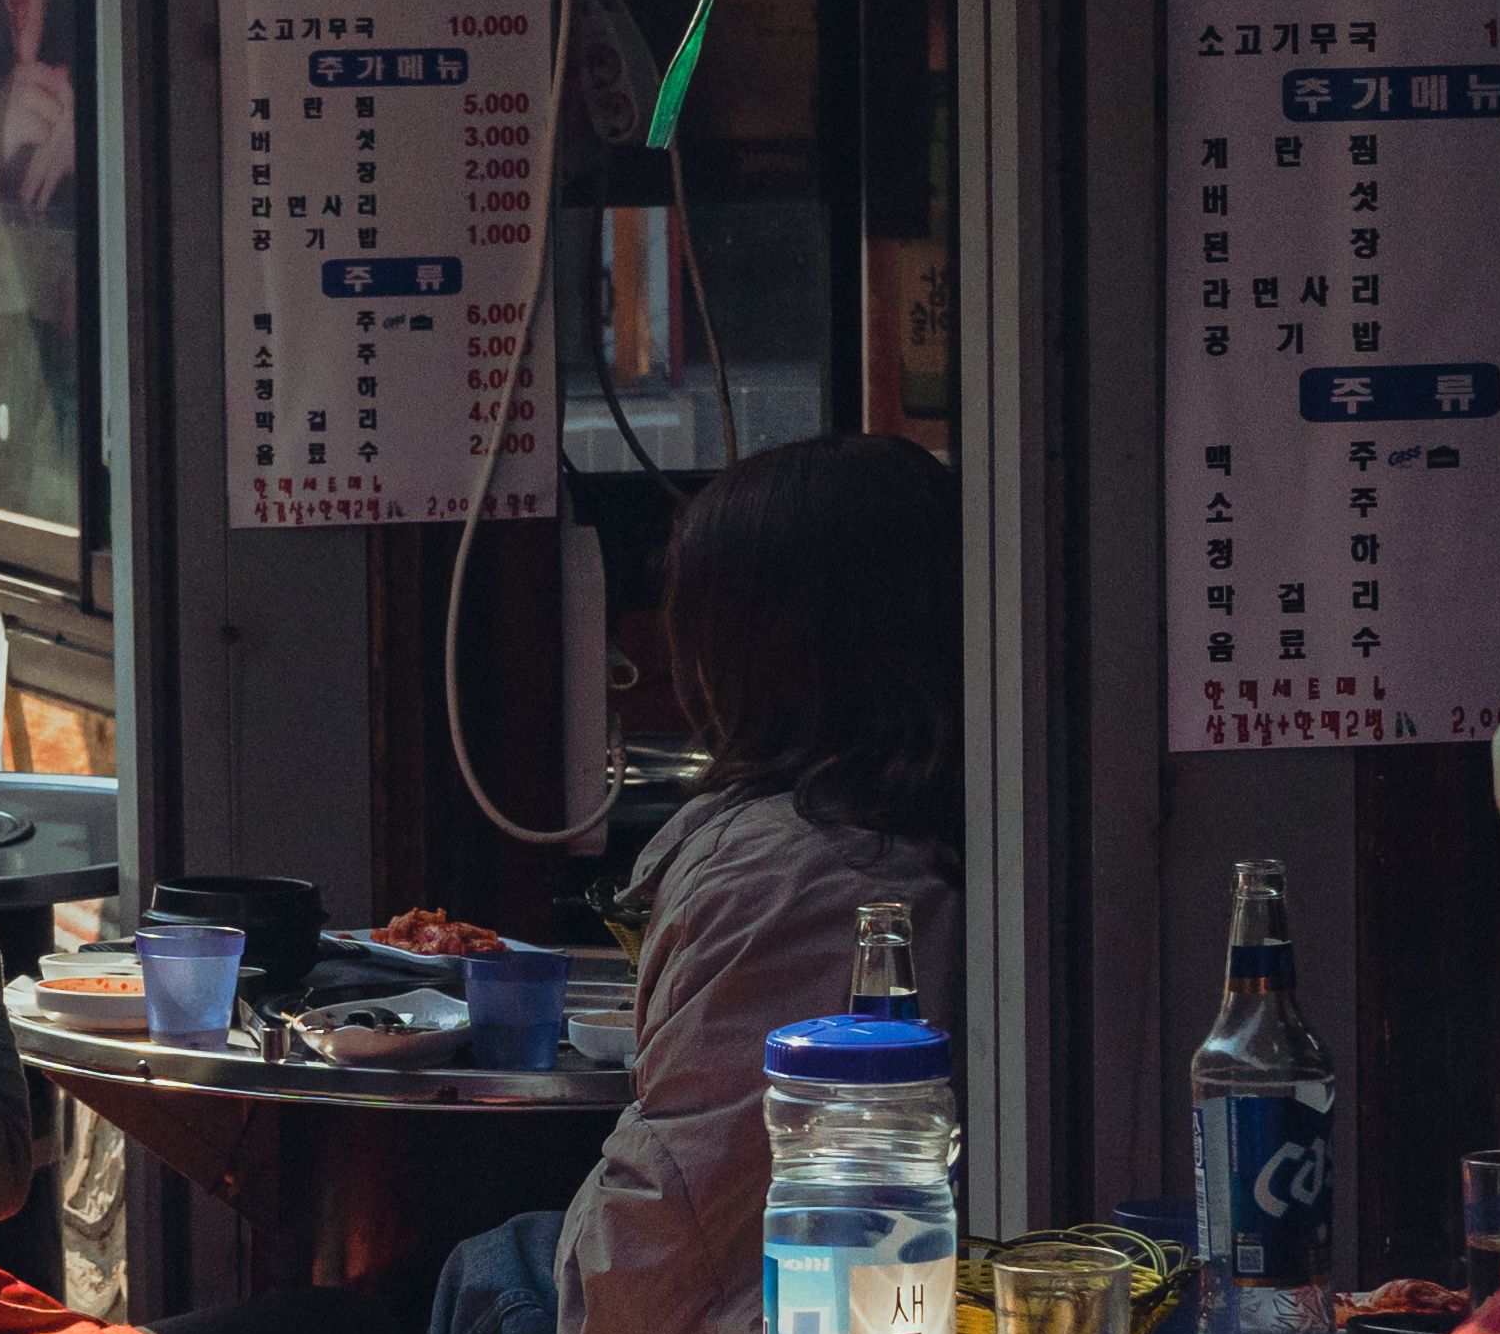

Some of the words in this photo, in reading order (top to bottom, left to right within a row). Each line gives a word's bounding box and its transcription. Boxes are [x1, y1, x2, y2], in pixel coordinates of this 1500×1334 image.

[449, 15, 528, 37] 10,000
[1198, 22, 1377, 57] 소고기무국
[464, 93, 529, 114] 5,000
[465, 125, 530, 147] 3,000
[1201, 135, 1377, 169] 계란찜
[466, 158, 530, 180] 2,000
[468, 191, 530, 212] 1,000
[1203, 181, 1378, 216] 버섯
[468, 223, 530, 245] 1,000
[1203, 228, 1380, 263] 된장
[1203, 274, 1379, 309] 라면사리
[1204, 321, 1381, 356] 공기밥
[1330, 374, 1476, 415] 주류
[1205, 441, 1377, 476] 맥주
[1206, 488, 1377, 523] 소주
[1207, 534, 1380, 569] 청하
[1207, 580, 1379, 616] 막걸리
[1208, 627, 1381, 662] 음료수
